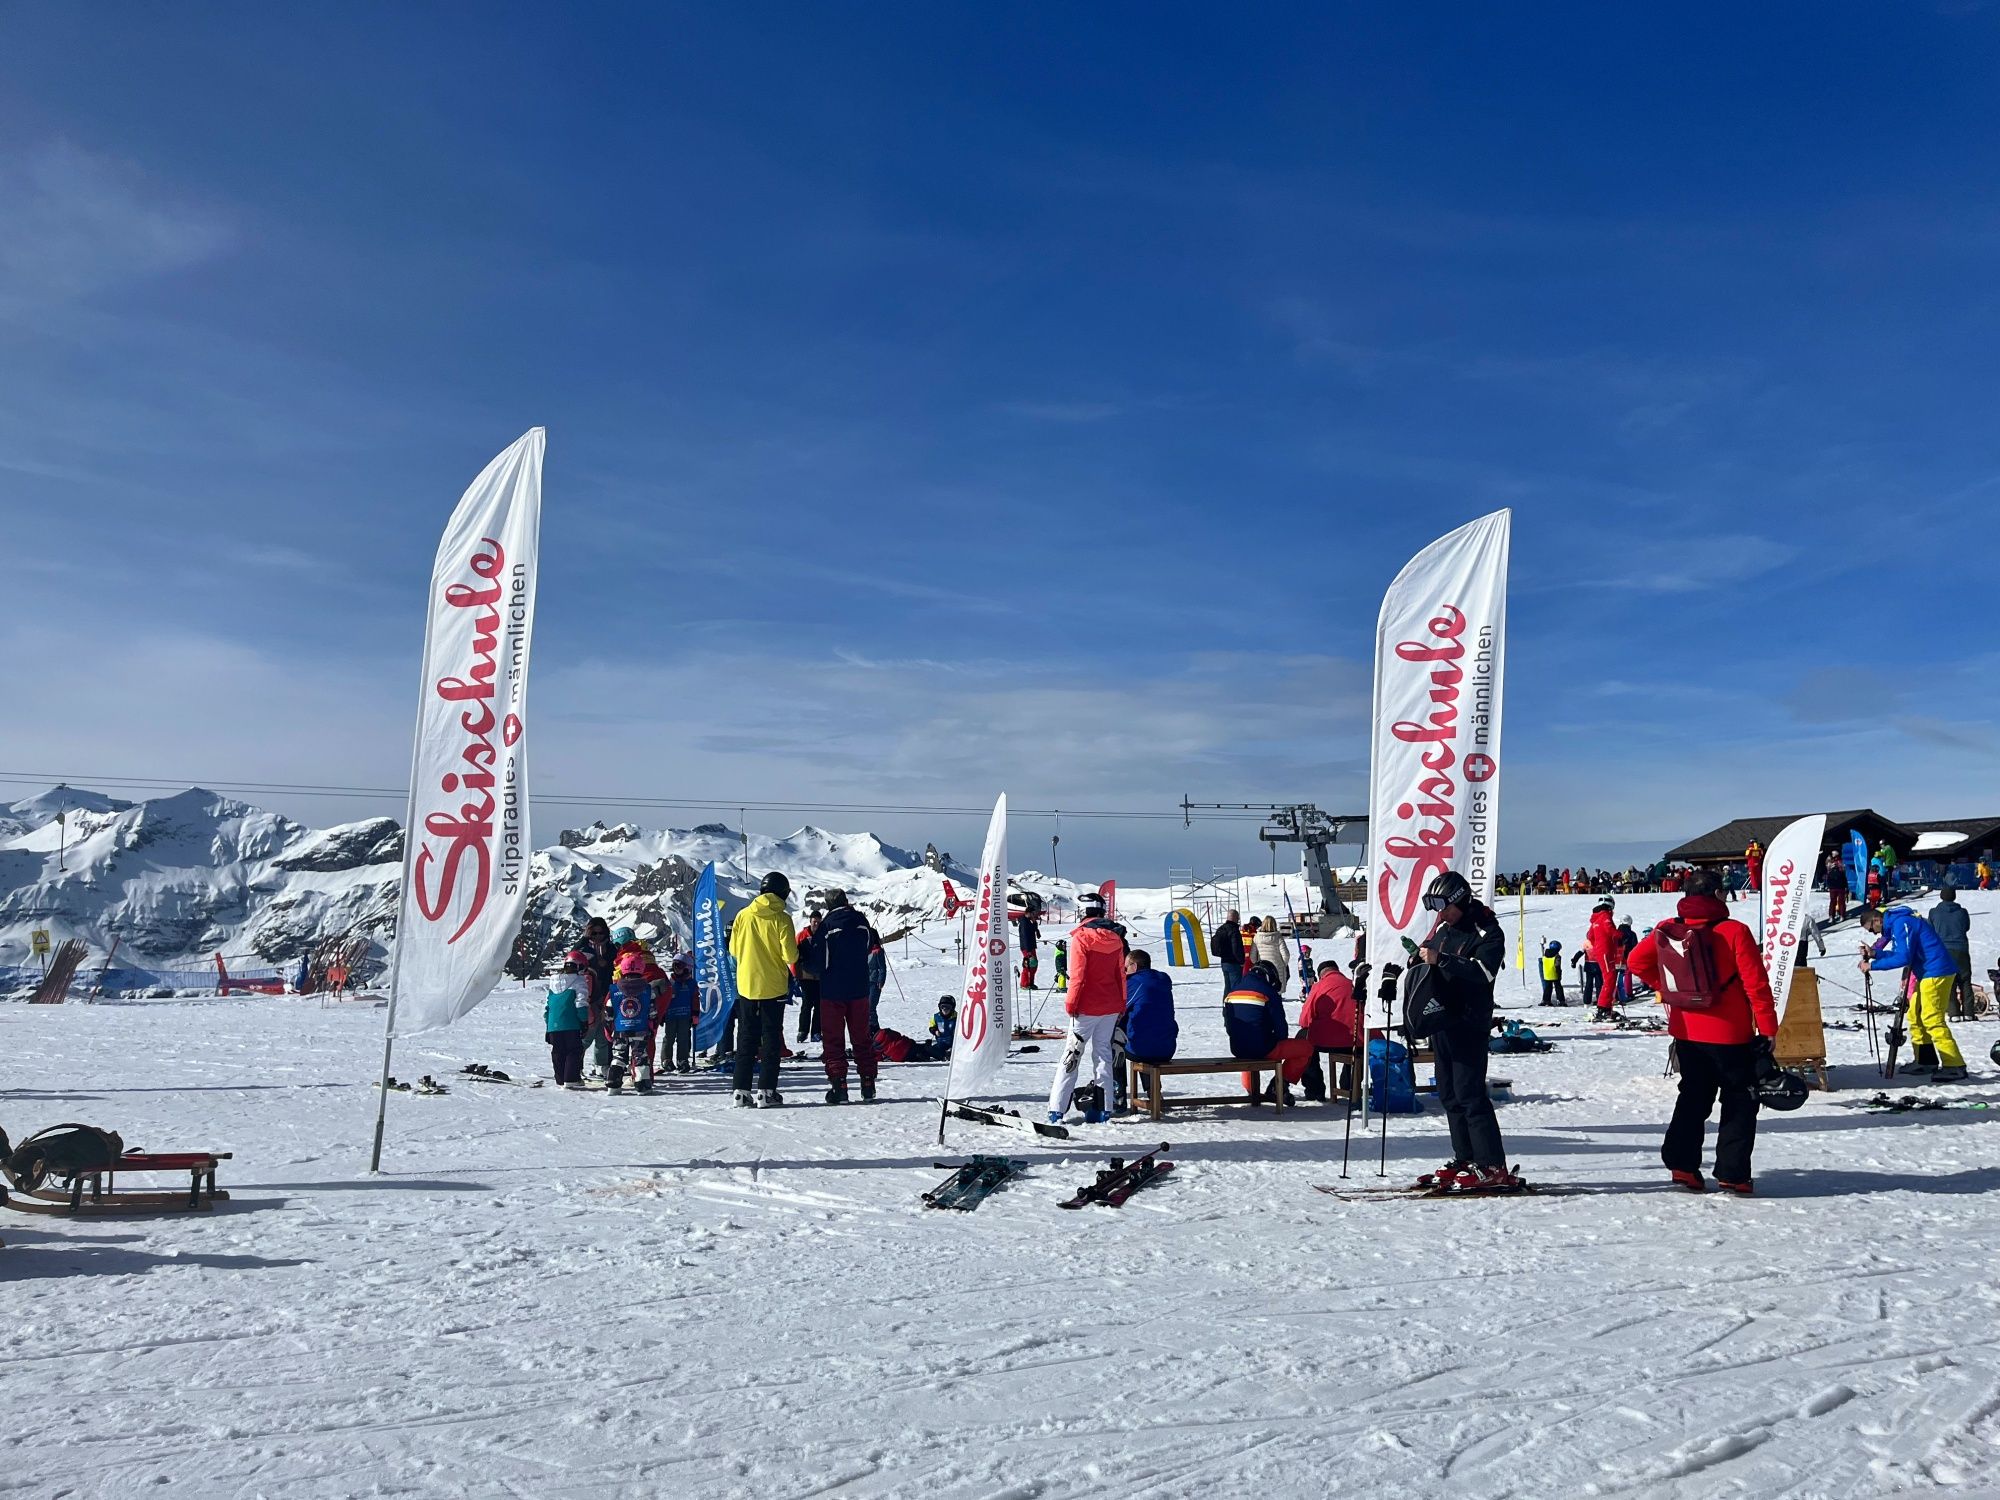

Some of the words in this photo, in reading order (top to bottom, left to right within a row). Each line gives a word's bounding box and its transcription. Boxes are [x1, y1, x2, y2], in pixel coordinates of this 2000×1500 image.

[507, 562, 526, 704] männlichen
[1472, 624, 1492, 746] männlichen
[415, 537, 505, 945] Skischule
[1379, 604, 1467, 948] Skischule
[502, 756, 522, 897] skiparadies
[1468, 790, 1488, 898] kiparadies
[697, 897, 723, 1020] Skischule
[991, 865, 1002, 935] männlichen
[1764, 859, 1794, 973] ischule
[1787, 872, 1807, 931] männlichen
[992, 959, 1005, 1030] skiparadies
